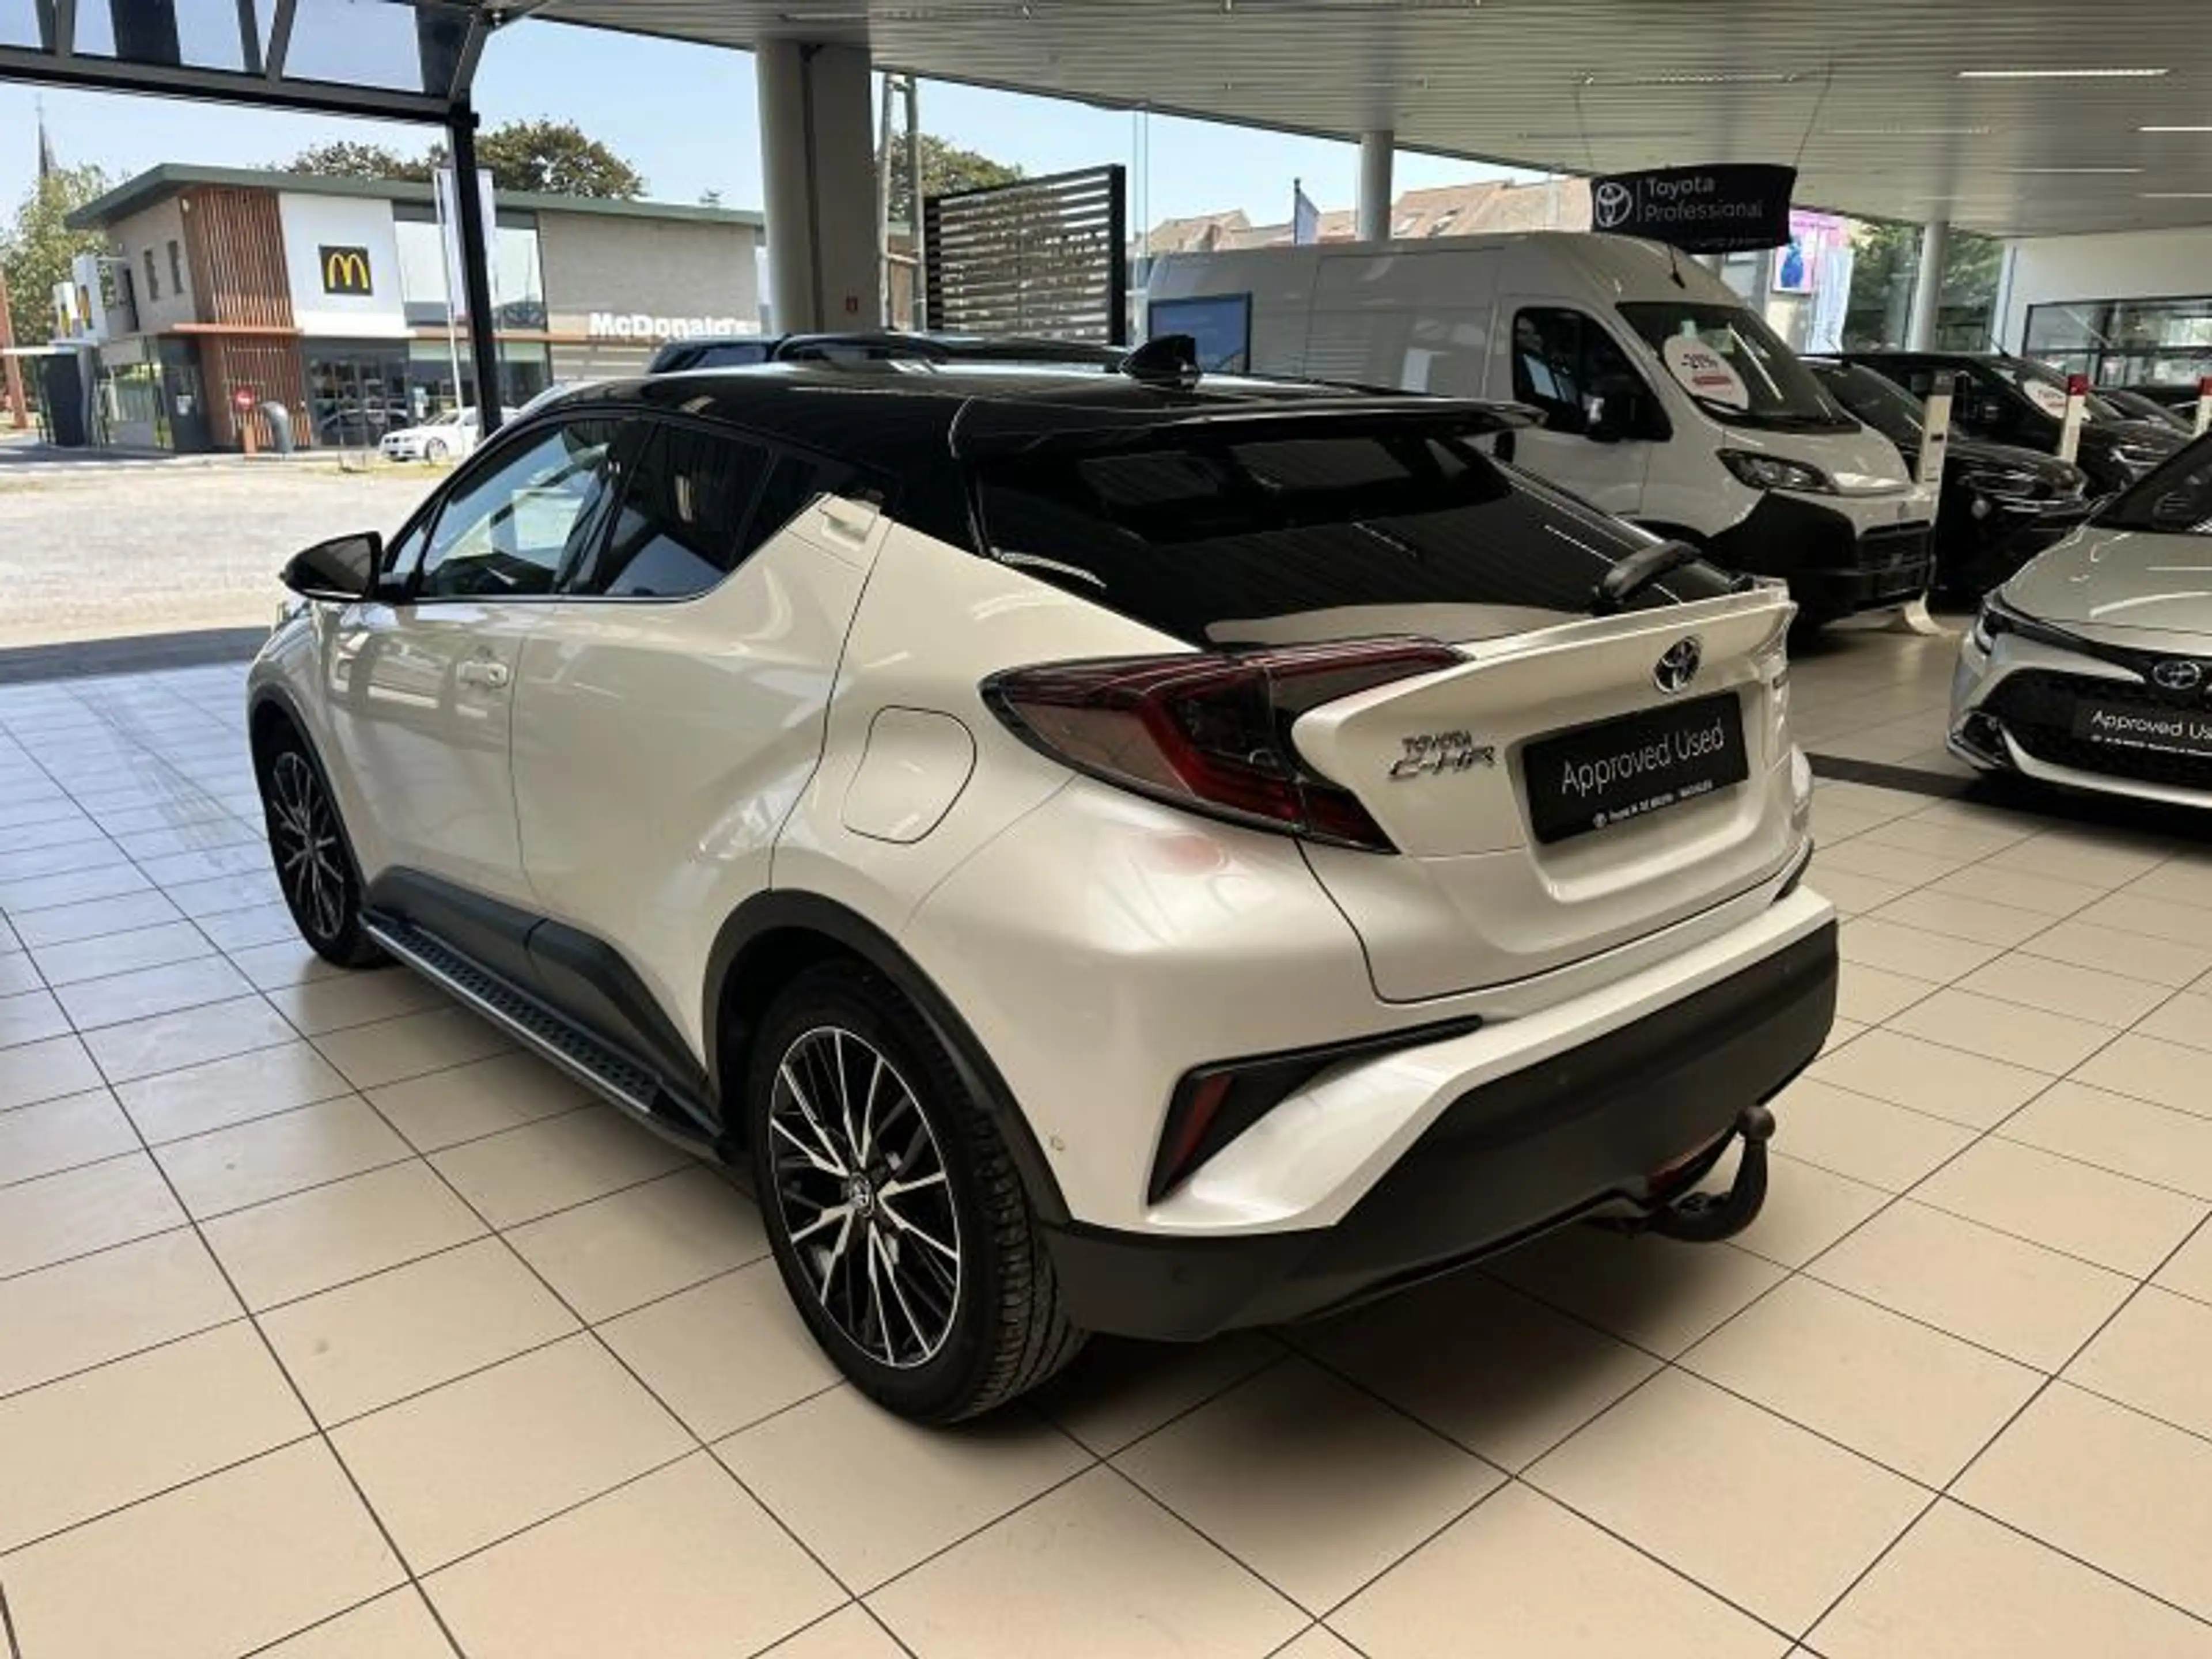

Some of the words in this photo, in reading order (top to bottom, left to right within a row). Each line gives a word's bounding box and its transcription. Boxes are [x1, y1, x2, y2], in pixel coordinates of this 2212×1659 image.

[1645, 176, 1715, 199] Toyota
[1645, 199, 1763, 222] Professional
[2091, 710, 2183, 737] Approved
[1402, 730, 1472, 753] TOYOTA
[1561, 733, 1670, 797] Approved
[1675, 717, 1725, 760] Used
